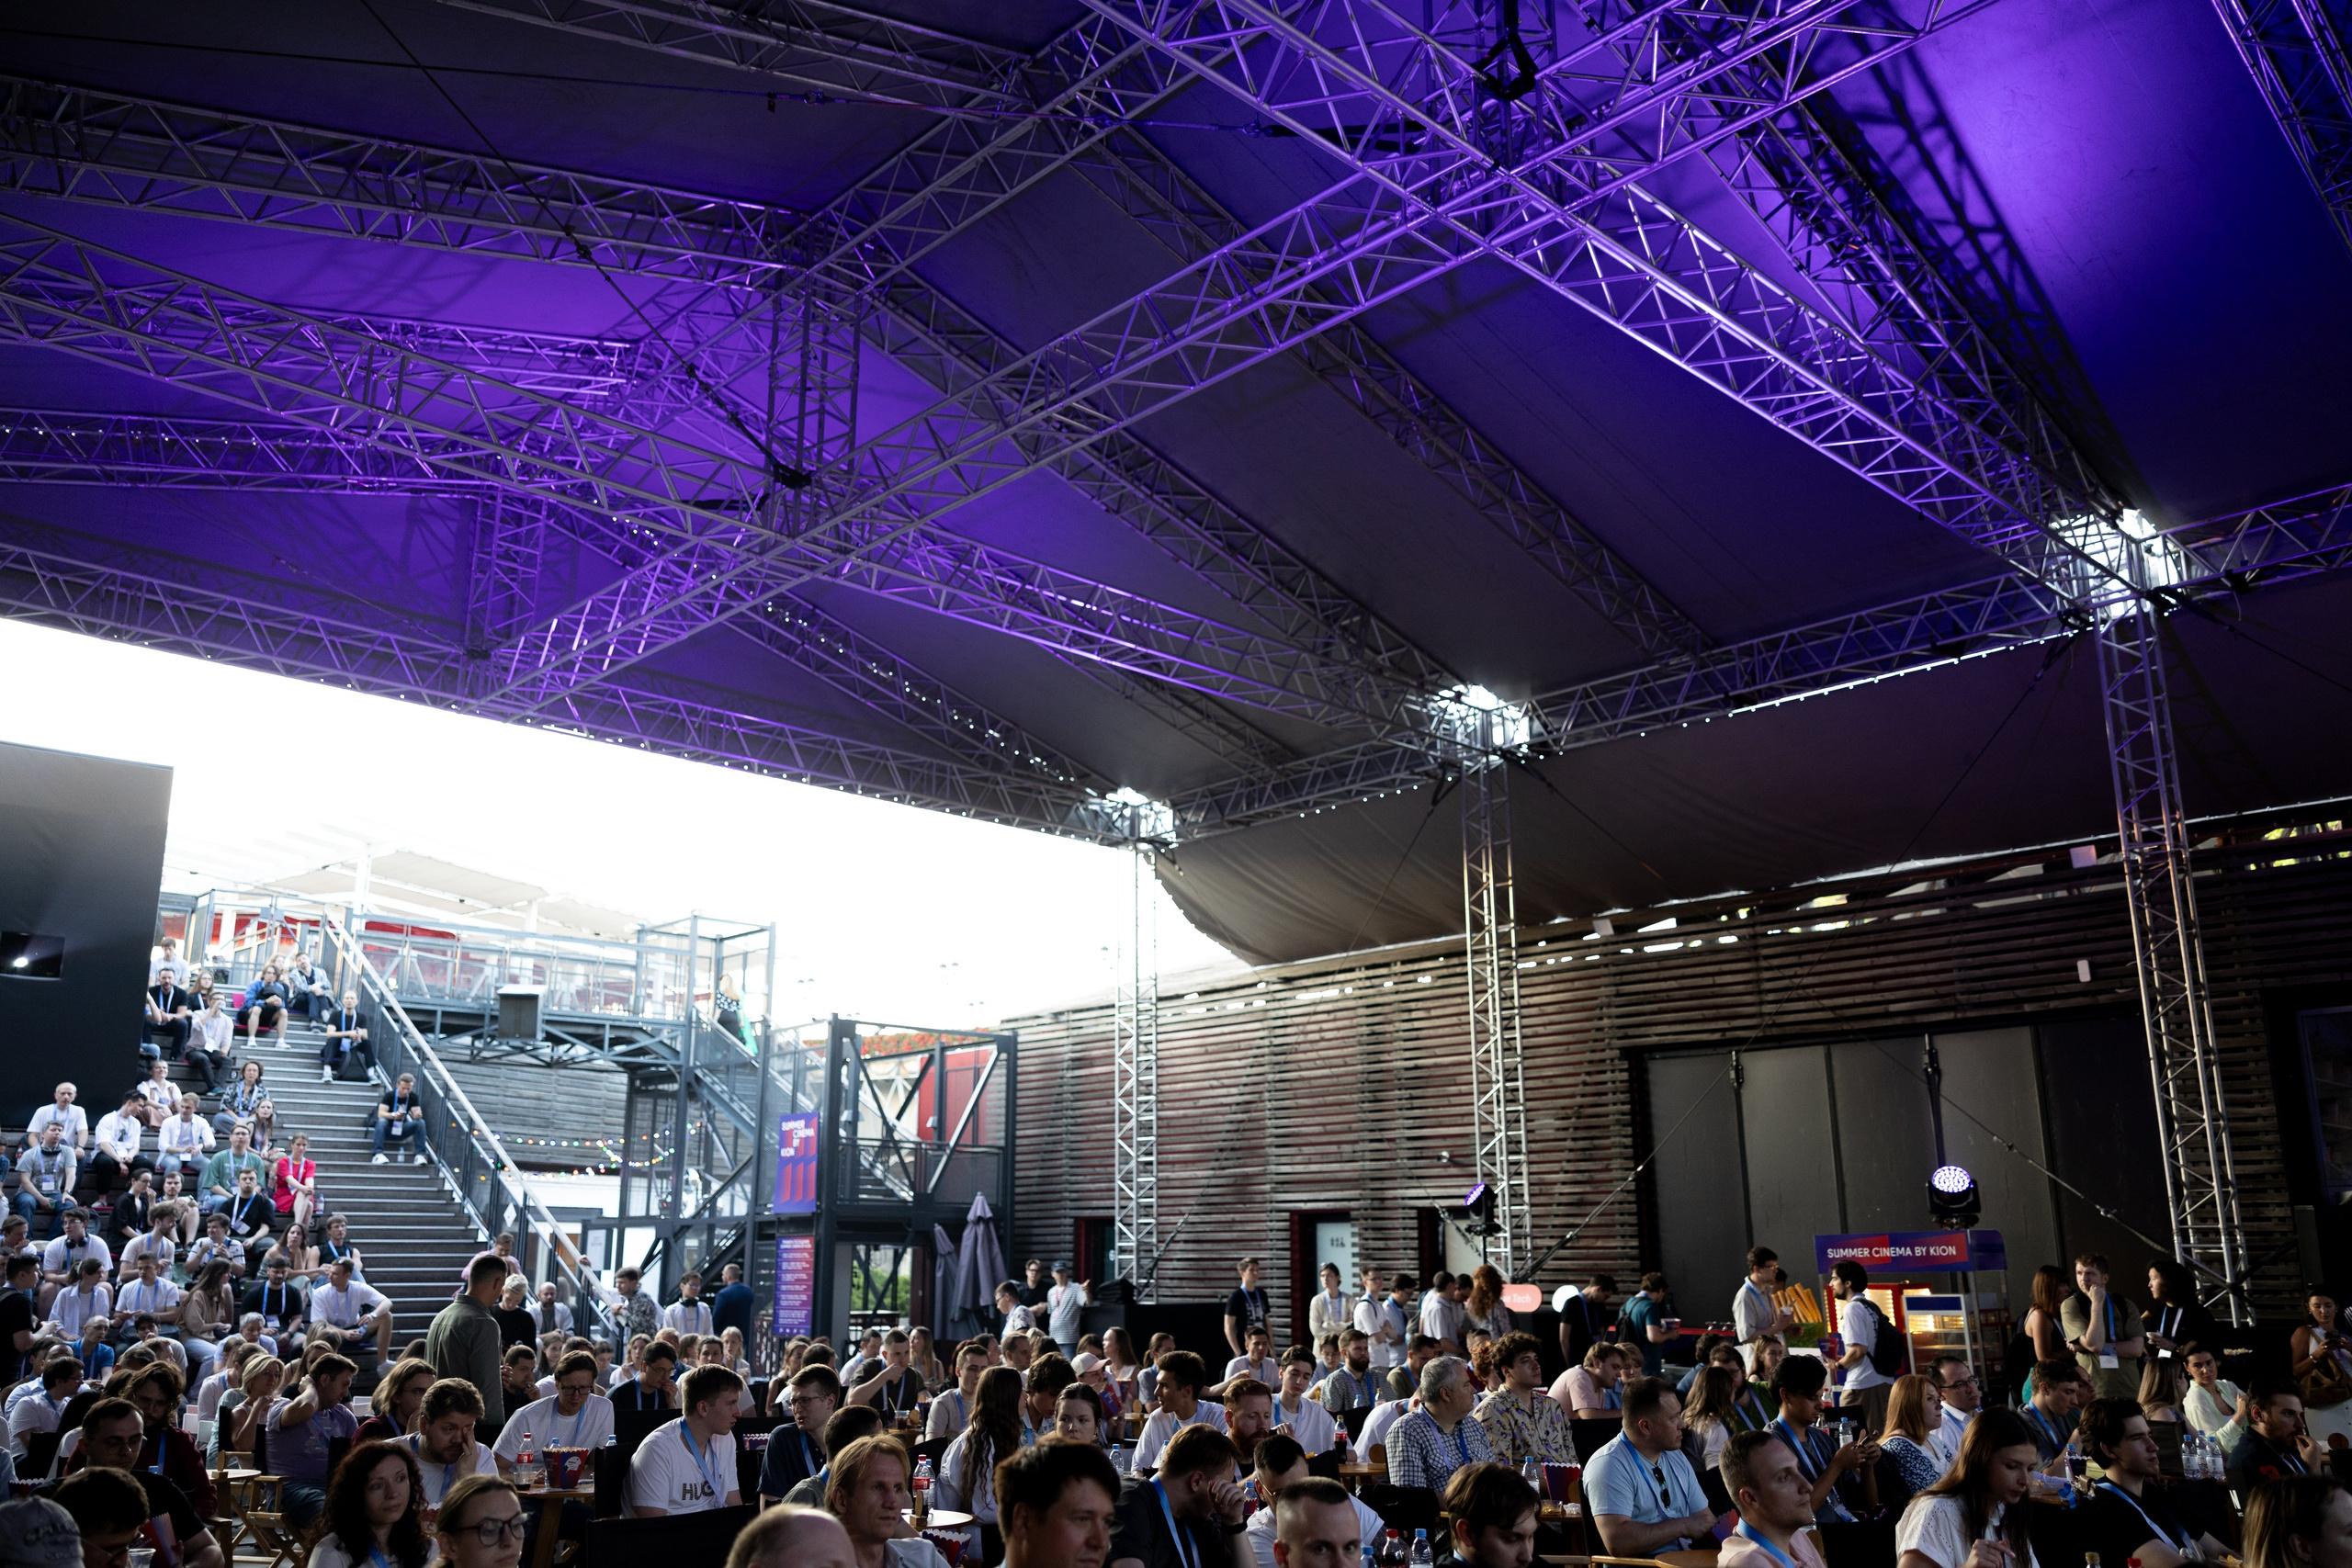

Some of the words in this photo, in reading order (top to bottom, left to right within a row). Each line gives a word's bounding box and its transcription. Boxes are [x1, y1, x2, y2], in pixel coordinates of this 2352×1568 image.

[781, 1119, 806, 1131] SUMMER
[793, 1127, 815, 1138] CINEMA
[793, 1138, 800, 1147] BY
[781, 1147, 795, 1156] KION
[1826, 1247, 1870, 1258] SUMMER
[1871, 1247, 1912, 1258] CINEMA
[1915, 1246, 1928, 1257] BY
[1929, 1246, 1957, 1257] KION
[1512, 1293, 1531, 1303] Tech
[682, 1480, 715, 1501] HUG
